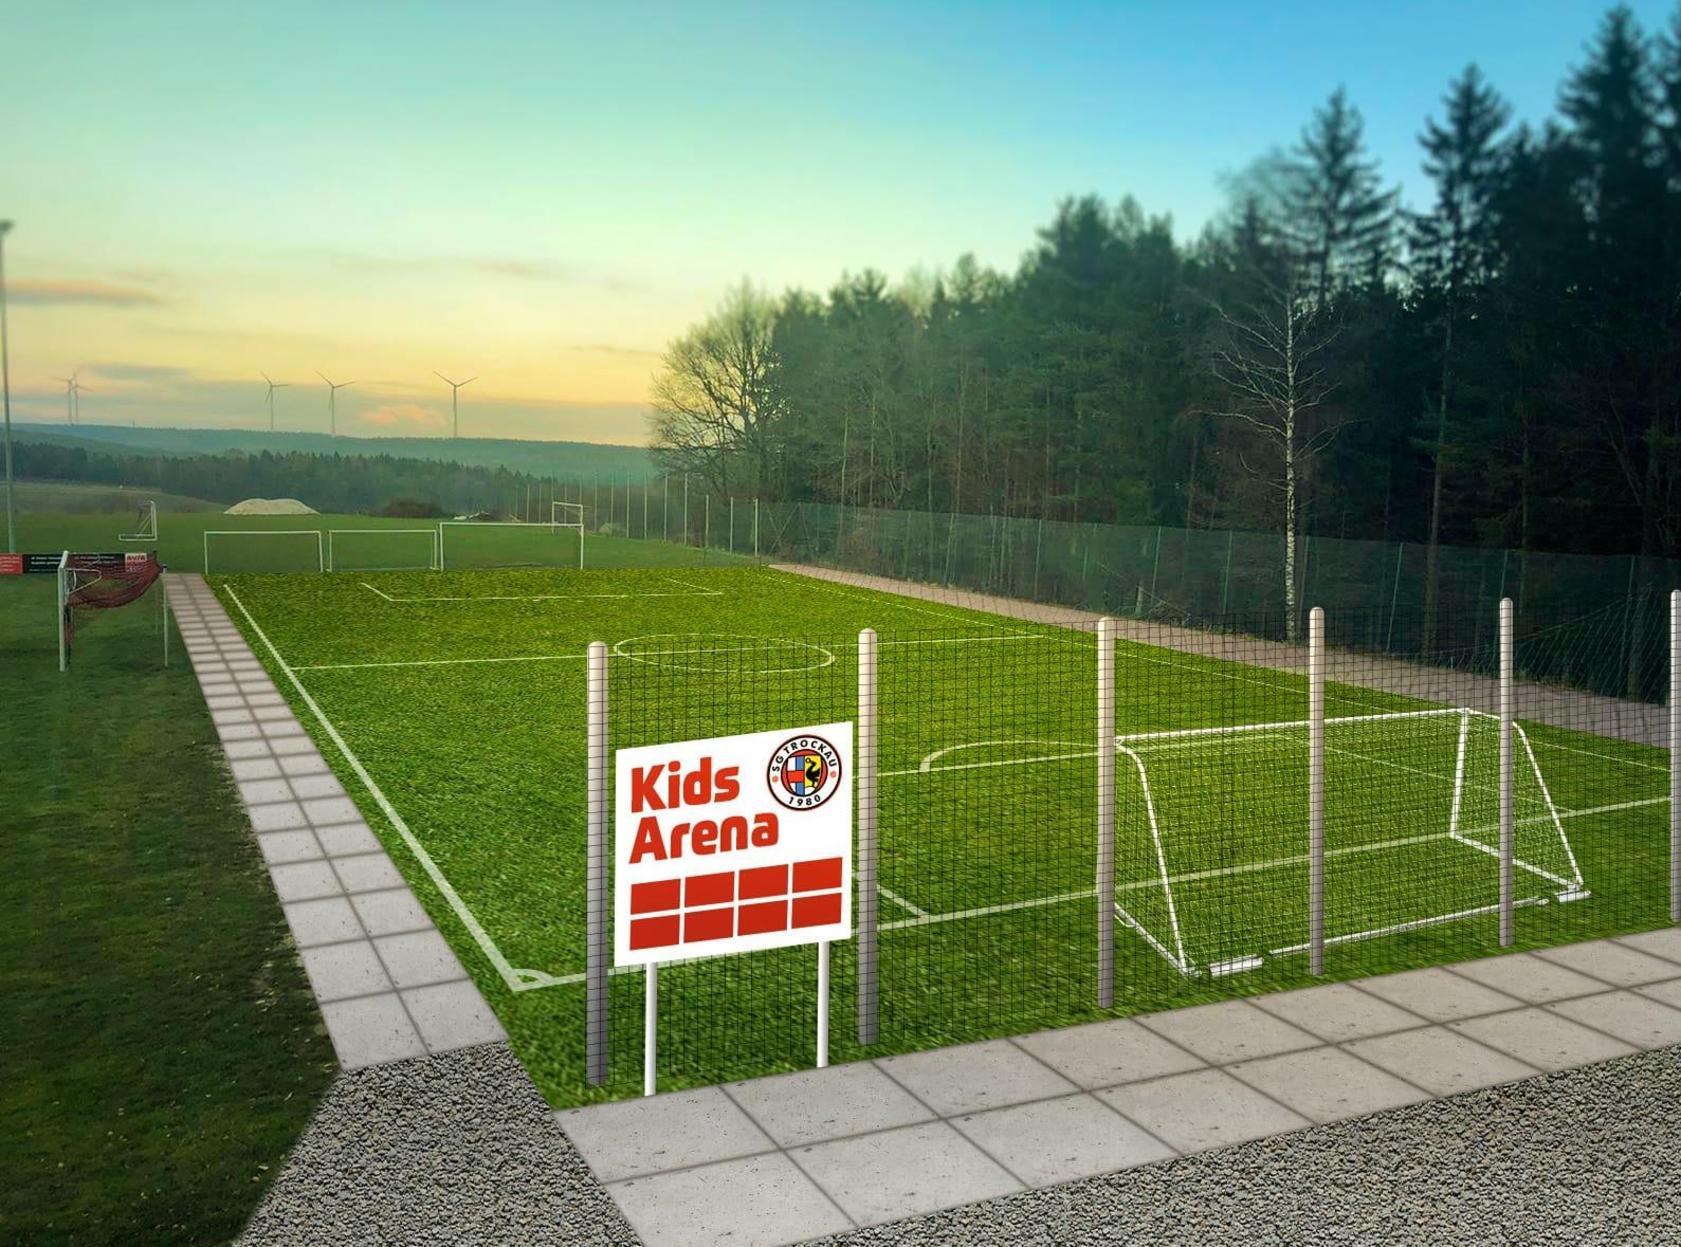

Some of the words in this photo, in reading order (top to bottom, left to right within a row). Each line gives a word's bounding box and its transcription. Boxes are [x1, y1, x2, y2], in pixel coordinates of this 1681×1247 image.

[771, 755, 784, 772] SG
[783, 739, 837, 767] TROCKAU
[631, 757, 740, 813] Kids
[789, 794, 821, 807] 1980
[628, 812, 779, 864] Arena
